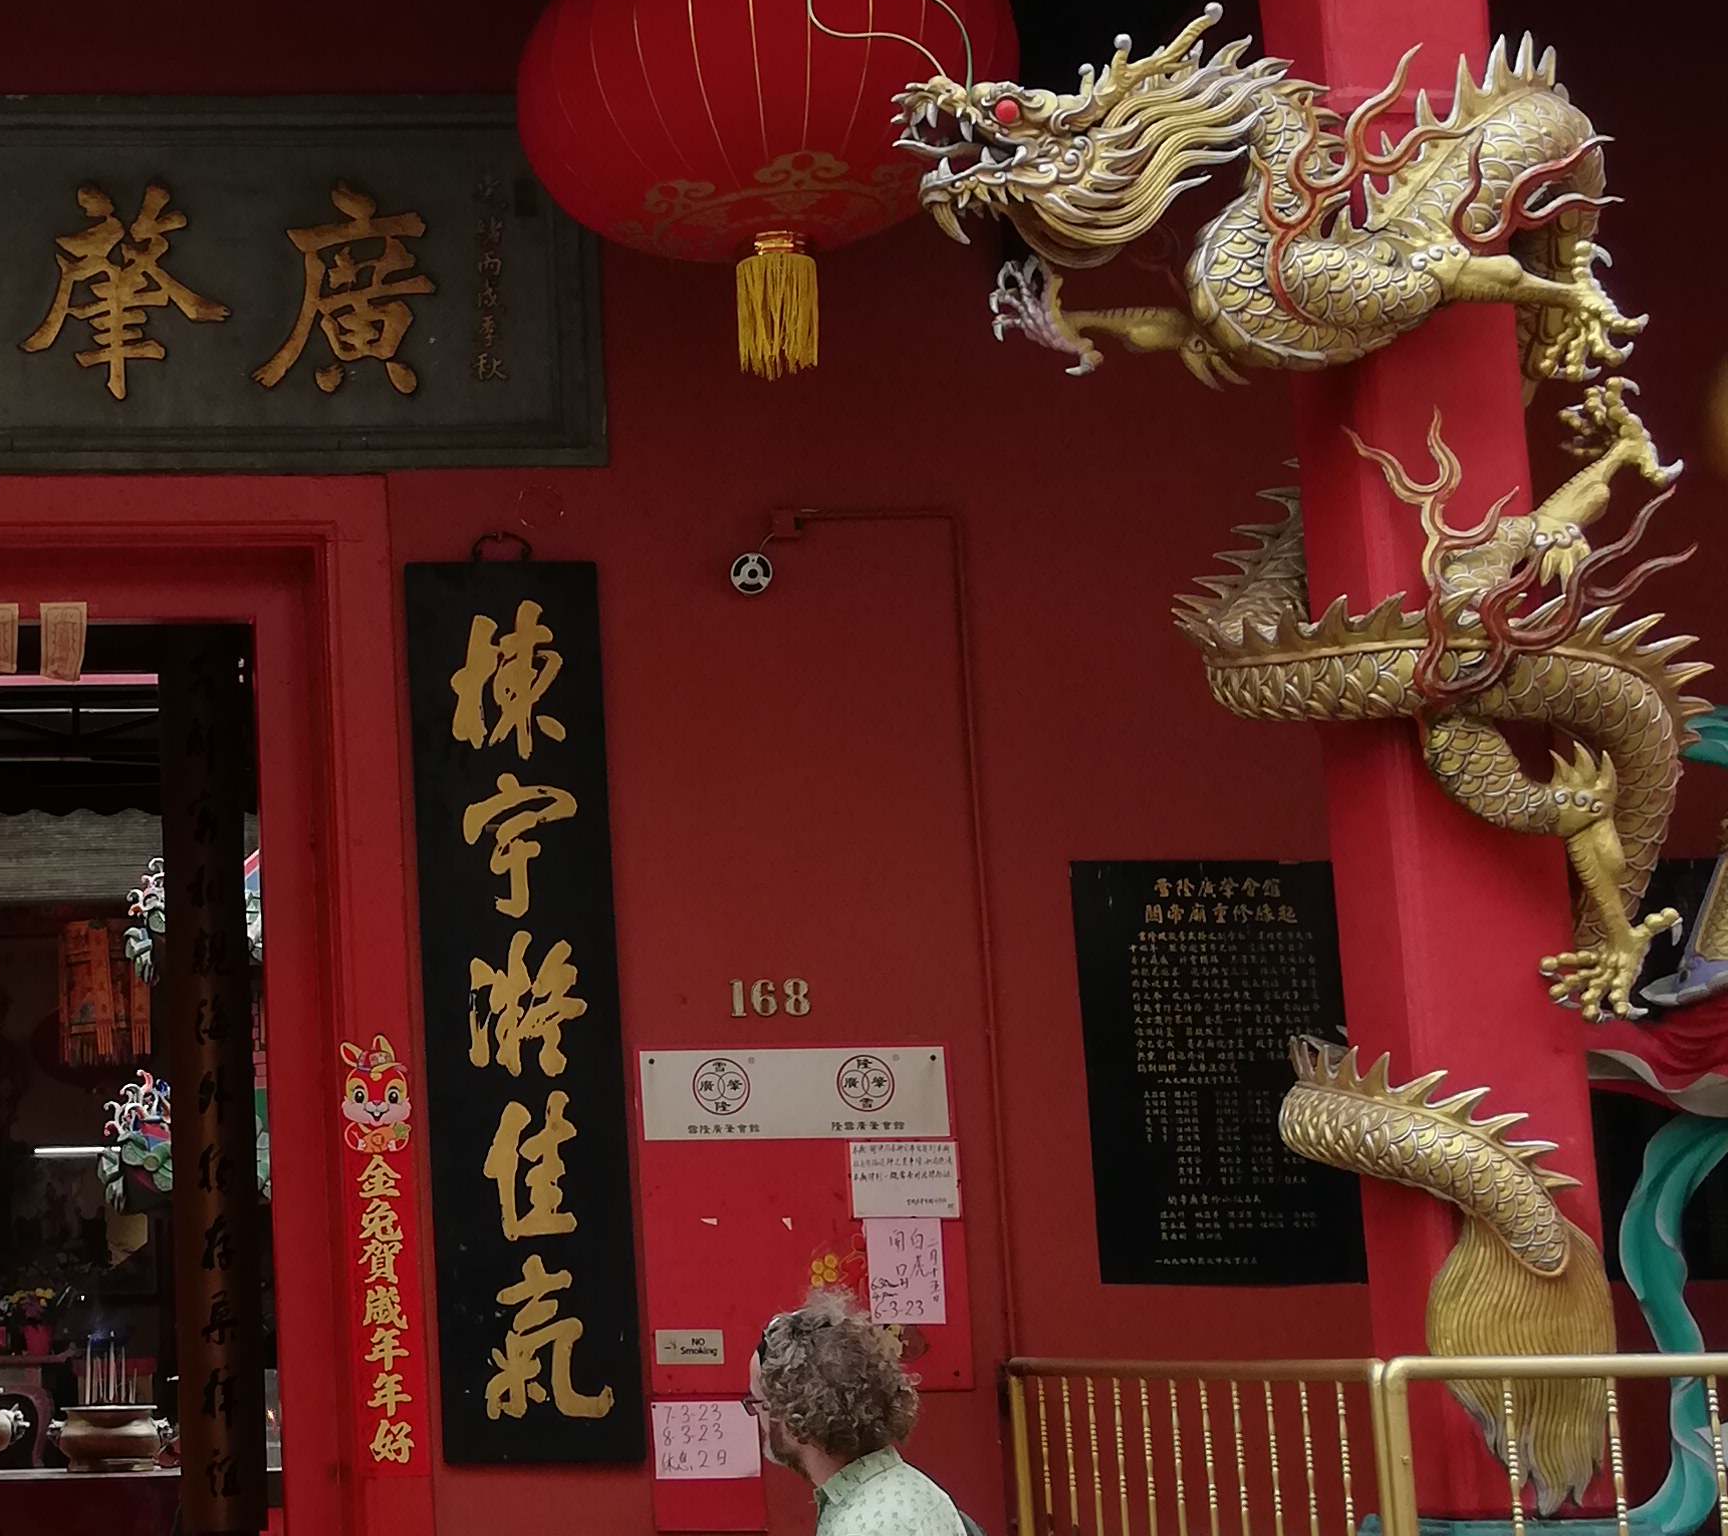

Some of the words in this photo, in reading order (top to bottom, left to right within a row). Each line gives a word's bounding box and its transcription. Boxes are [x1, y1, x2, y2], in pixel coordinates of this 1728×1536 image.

[729, 976, 811, 1018] 168
[874, 1300, 925, 1319] 6-3-23
[680, 1346, 718, 1357] Smoking
[691, 1337, 706, 1346] NO
[663, 1403, 722, 1425] 7-3-23
[662, 1423, 723, 1446] 8-3-23
